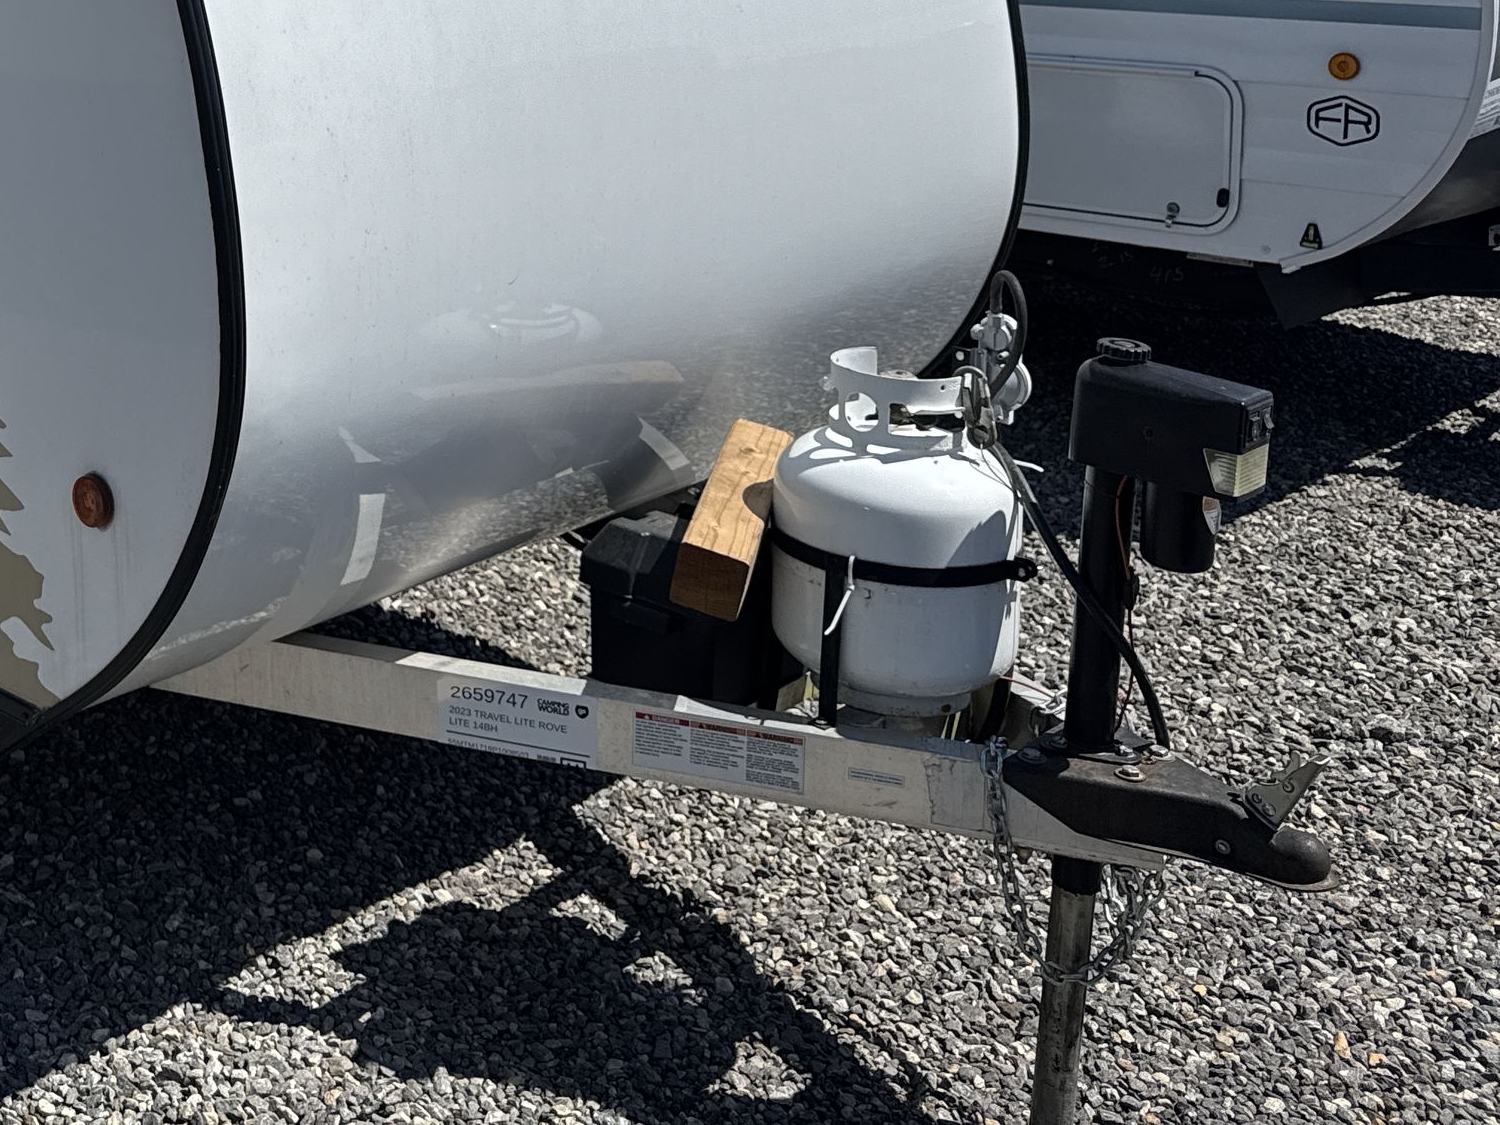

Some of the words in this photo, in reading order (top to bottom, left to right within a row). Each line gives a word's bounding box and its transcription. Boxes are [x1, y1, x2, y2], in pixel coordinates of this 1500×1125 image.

[1314, 102, 1372, 140] FR
[450, 685, 528, 709] 2659747
[537, 698, 570, 710] CAMPING
[449, 705, 472, 717] 2023
[474, 709, 512, 725] TRAVEL
[515, 715, 535, 728] LITE
[538, 720, 568, 734] ROVE
[538, 705, 570, 716] WORLD
[449, 717, 470, 728] LITE
[473, 721, 498, 732] 14BH
